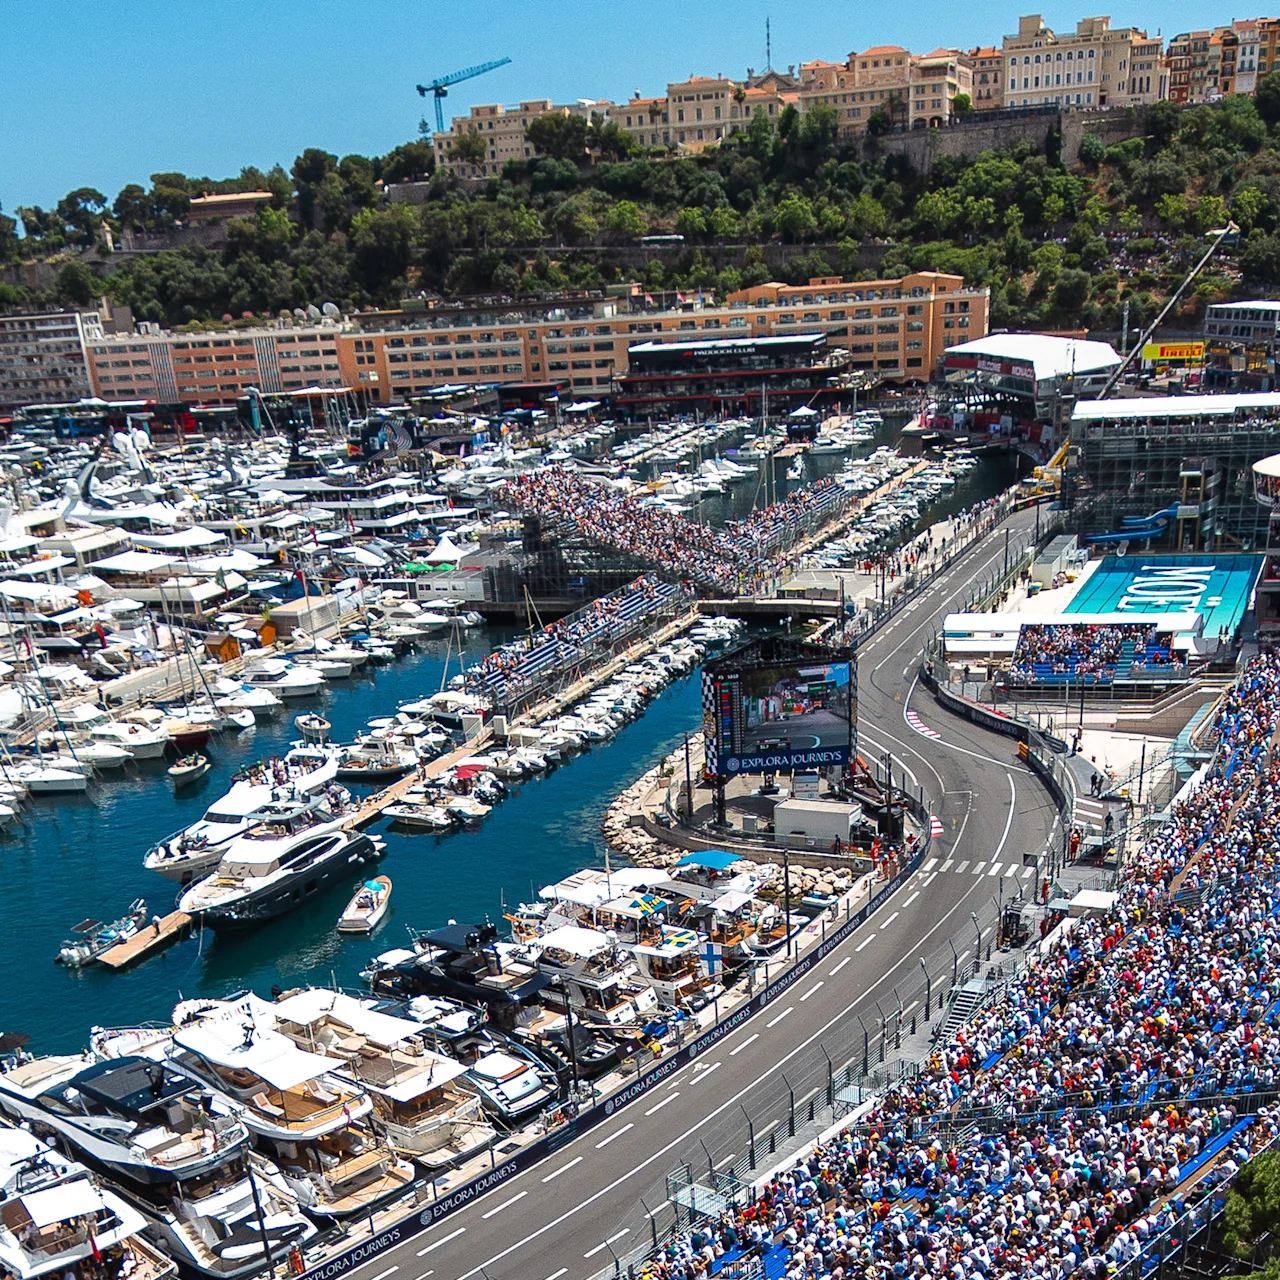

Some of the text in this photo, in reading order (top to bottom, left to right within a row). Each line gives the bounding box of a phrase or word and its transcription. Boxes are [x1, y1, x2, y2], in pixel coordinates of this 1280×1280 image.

[1117, 565, 1222, 614] MOË
[742, 751, 842, 769] EXPLORA JOURNEYS
[614, 1059, 678, 1106] EXPLORA JOURNEYS
[433, 1161, 517, 1217] EXPLORA JOURNEYS
[351, 1228, 401, 1265] JOURNEYS
